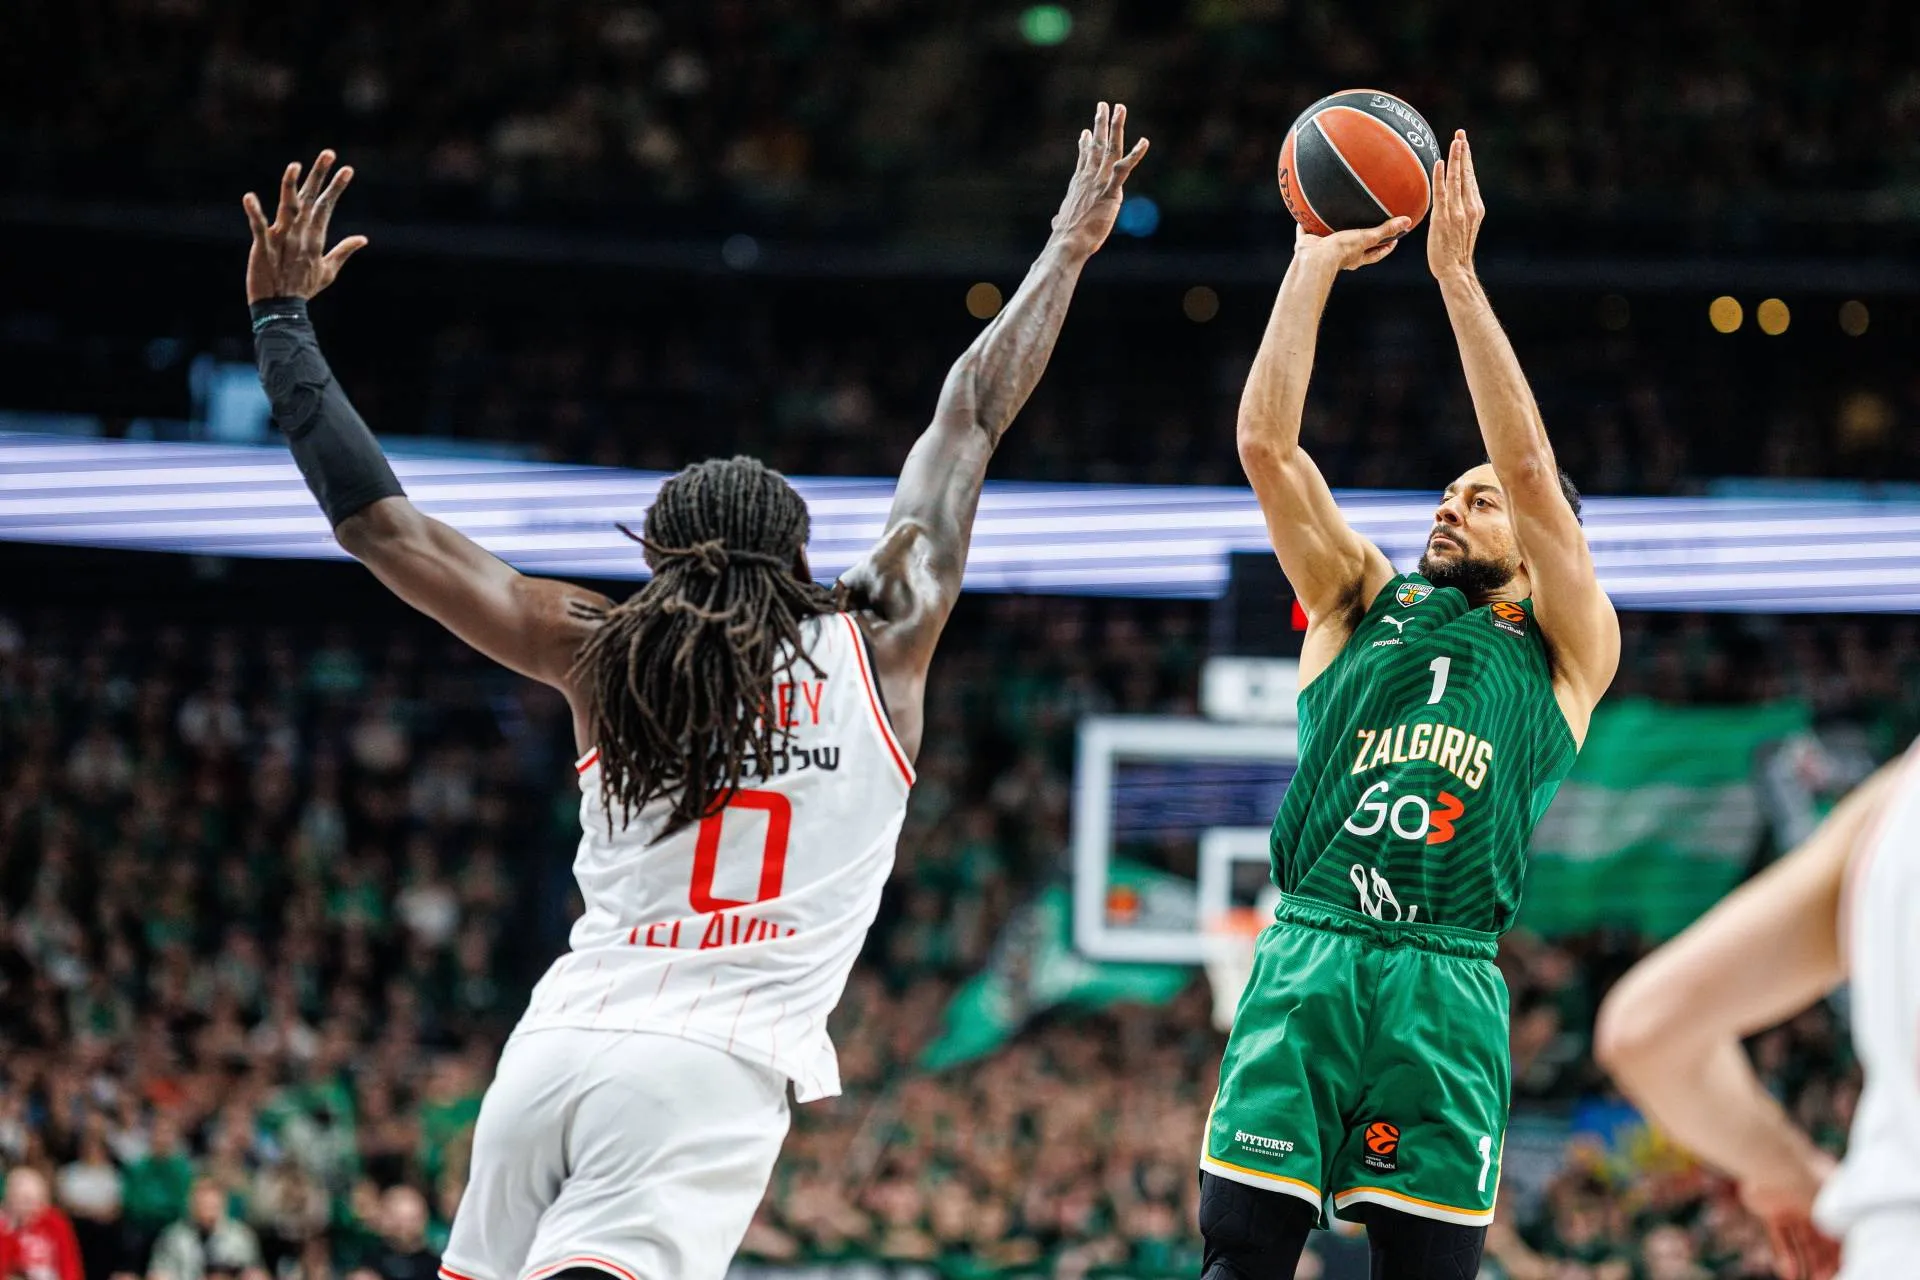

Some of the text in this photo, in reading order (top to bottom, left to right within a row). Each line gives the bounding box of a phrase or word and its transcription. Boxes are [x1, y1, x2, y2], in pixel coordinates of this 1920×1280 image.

[1370, 94, 1441, 161] ALDING
[1426, 656, 1451, 705] 1
[689, 787, 792, 914] 0
[1235, 1129, 1294, 1152] ŠVYTURYS
[1477, 1135, 1492, 1192] 1
